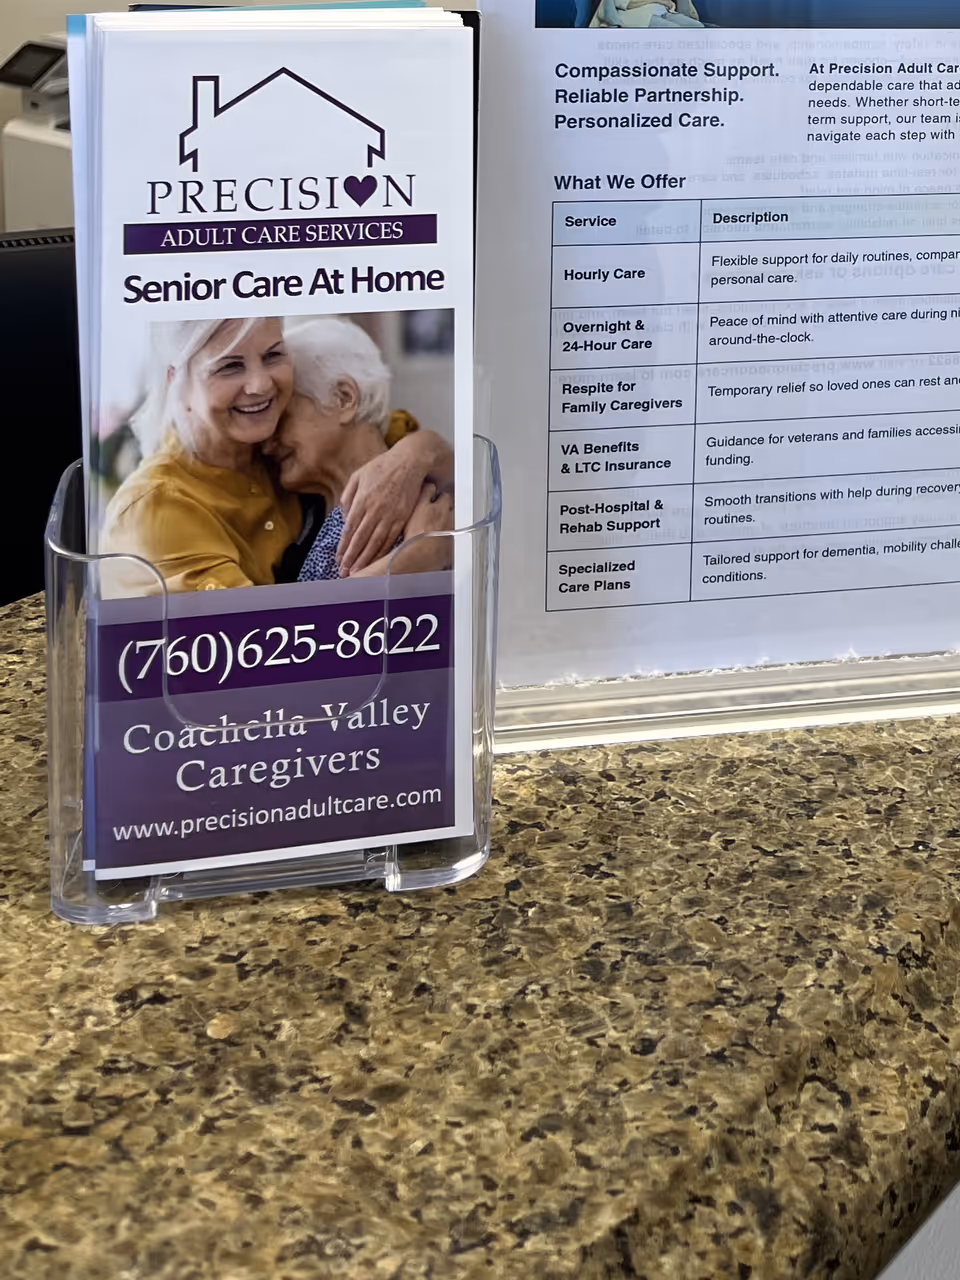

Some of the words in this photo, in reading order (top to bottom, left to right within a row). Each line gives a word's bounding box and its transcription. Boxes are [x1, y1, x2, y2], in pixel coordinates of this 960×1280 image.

[554, 60, 698, 81] Compassionate
[703, 61, 779, 80] Support.
[808, 62, 824, 74] At
[828, 61, 892, 74] Precision
[897, 61, 932, 73] Adult
[805, 78, 883, 93] dependable
[886, 81, 914, 90] care
[918, 77, 942, 90] that
[554, 87, 628, 103] Reliable
[634, 87, 743, 105] Partnership.
[804, 96, 850, 108] needs.
[855, 95, 909, 107] Whether
[554, 112, 672, 129] Personalized
[678, 112, 724, 127] Care.
[807, 114, 836, 125] term
[840, 113, 891, 127] support,
[895, 115, 917, 123] our
[920, 113, 951, 123] team
[806, 129, 861, 144] navigate
[865, 128, 895, 140] each
[899, 129, 926, 142] step
[929, 128, 955, 139] with
[553, 174, 601, 190] What
[605, 174, 635, 189] We
[640, 173, 686, 188] Offer
[564, 215, 617, 230] Service
[711, 210, 789, 225] Description
[159, 227, 236, 246] ADULT
[241, 224, 300, 244] CARE
[305, 221, 403, 242] SERVICES
[711, 254, 758, 266] Flexible
[761, 253, 808, 269] support
[811, 252, 828, 264] for
[830, 251, 859, 265] daily
[862, 250, 912, 262] routines,
[563, 268, 610, 282] Hourly
[613, 267, 645, 279] Care
[710, 271, 764, 288] personal
[767, 274, 797, 283] care.
[123, 271, 227, 303] Senior
[232, 270, 303, 298] Care
[307, 267, 344, 295] At
[351, 265, 445, 293] Home
[709, 314, 748, 327] Peace
[751, 313, 764, 325] of
[766, 312, 797, 325] mind
[799, 311, 824, 323] with
[827, 310, 878, 322] attentive
[881, 311, 907, 320] care
[910, 307, 947, 321] during
[562, 319, 631, 334] Overnight
[634, 319, 644, 330] &
[561, 339, 617, 352] 24-Hour
[620, 338, 652, 349] Care
[708, 330, 814, 346] around-the-clock.
[562, 382, 613, 396] Respite
[616, 380, 636, 392] for
[707, 385, 773, 398] Temporary
[776, 381, 806, 393] relief
[808, 383, 823, 392] so
[827, 378, 858, 391] loved
[861, 379, 890, 389] ones
[893, 378, 915, 387] can
[918, 375, 941, 386] rest
[561, 400, 606, 414] Family
[609, 397, 682, 412] Caregivers
[706, 435, 764, 447] Guidance
[768, 433, 784, 444] for
[787, 432, 838, 443] veterans
[841, 428, 864, 440] and
[867, 424, 911, 438] families
[560, 443, 579, 455] VA
[583, 440, 639, 454] Benefits
[560, 462, 570, 474] &
[575, 461, 601, 473] LTC
[604, 459, 671, 471] Insurance
[704, 453, 753, 466] funding.
[703, 493, 751, 507] Smooth
[754, 490, 816, 504] transitions
[819, 488, 843, 500] with
[847, 486, 872, 500] help
[875, 481, 912, 501] during
[559, 499, 649, 515] Post-Hospital
[653, 499, 663, 509] &
[559, 520, 602, 534] Rehab
[606, 517, 660, 533] Support
[703, 512, 755, 525] routines.
[702, 551, 750, 566] Tailored
[753, 548, 799, 564] support
[802, 547, 819, 559] for
[821, 542, 879, 557] dementia,
[883, 540, 927, 554] mobility
[558, 559, 636, 575] Specialized
[701, 570, 766, 583] conditions.
[558, 582, 589, 593] Care
[593, 579, 631, 591] Plans
[118, 613, 441, 694] (760)625-8622
[122, 708, 309, 754] Coachella
[320, 697, 431, 732] Valley
[175, 747, 380, 791] Caregivers
[112, 785, 442, 841] www.precisionadultcare.com
